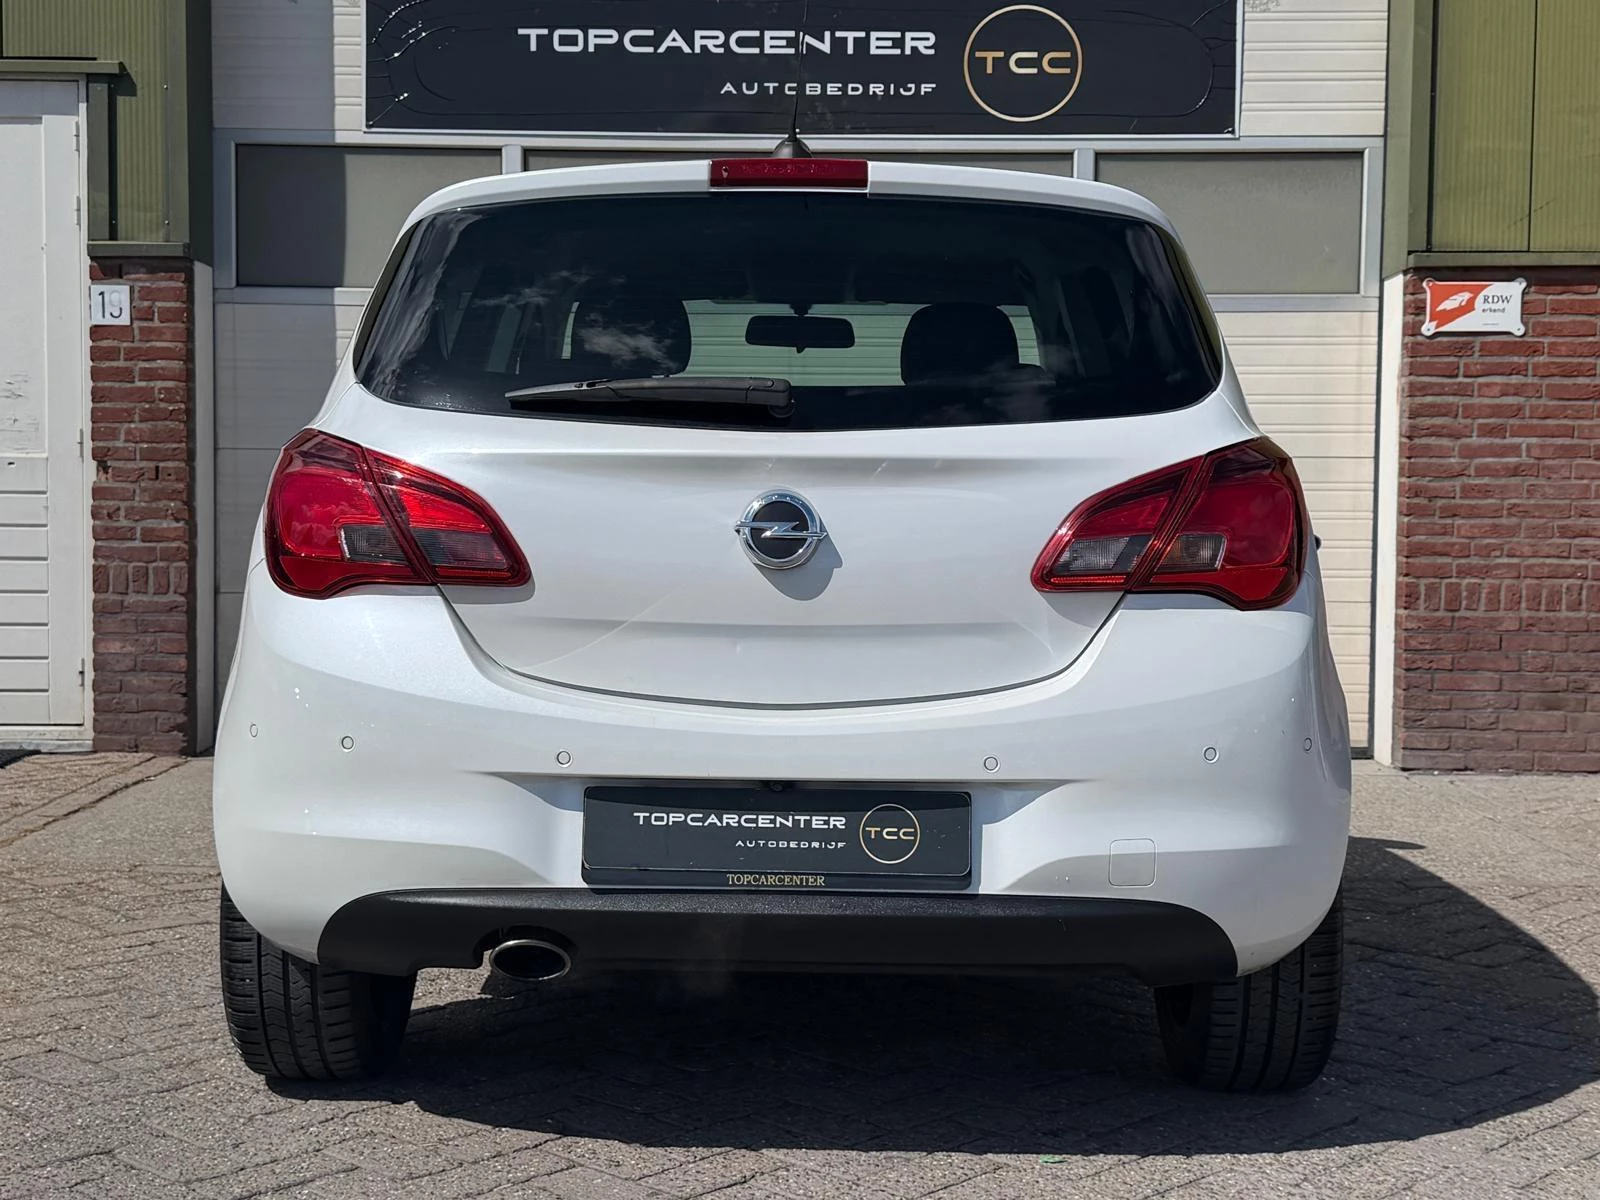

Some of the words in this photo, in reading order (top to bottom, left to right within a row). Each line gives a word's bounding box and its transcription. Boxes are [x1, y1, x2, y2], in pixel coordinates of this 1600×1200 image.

[518, 28, 937, 55] TOPCARCENTER
[975, 51, 1071, 74] TCC
[720, 82, 937, 96] AUTOBEDRIJF
[1482, 294, 1512, 304] RDW
[633, 811, 846, 830] TOPCARCENTER
[866, 826, 915, 840] TCC
[735, 840, 847, 849] AUTOBEDRIJF
[726, 873, 826, 887] TOPCARCENTER
